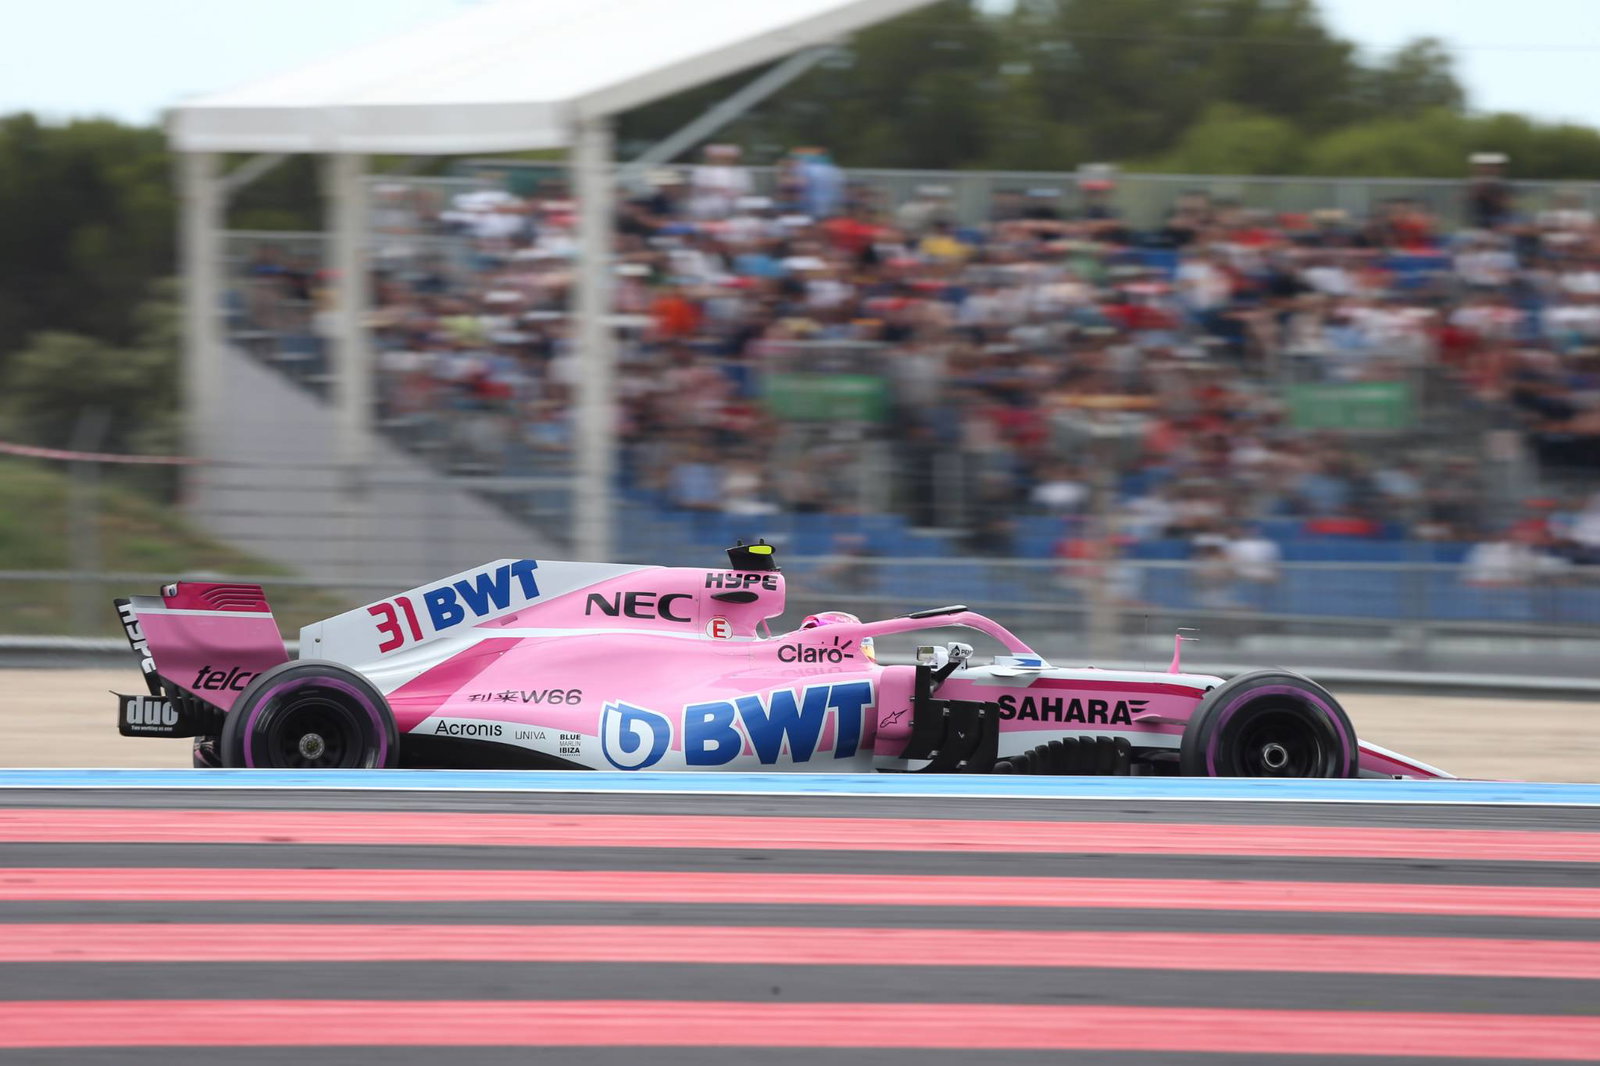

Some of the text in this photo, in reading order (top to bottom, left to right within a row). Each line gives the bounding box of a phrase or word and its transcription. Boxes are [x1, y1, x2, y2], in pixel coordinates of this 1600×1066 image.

[423, 559, 540, 631] BWT
[705, 572, 778, 591] HYPE
[585, 591, 693, 622] NEC
[367, 596, 424, 654] 31
[712, 620, 726, 639] E
[777, 643, 843, 663] Claro
[684, 680, 873, 766] BWT
[998, 695, 1132, 725] SAHARA
[434, 720, 502, 737] Acronis
